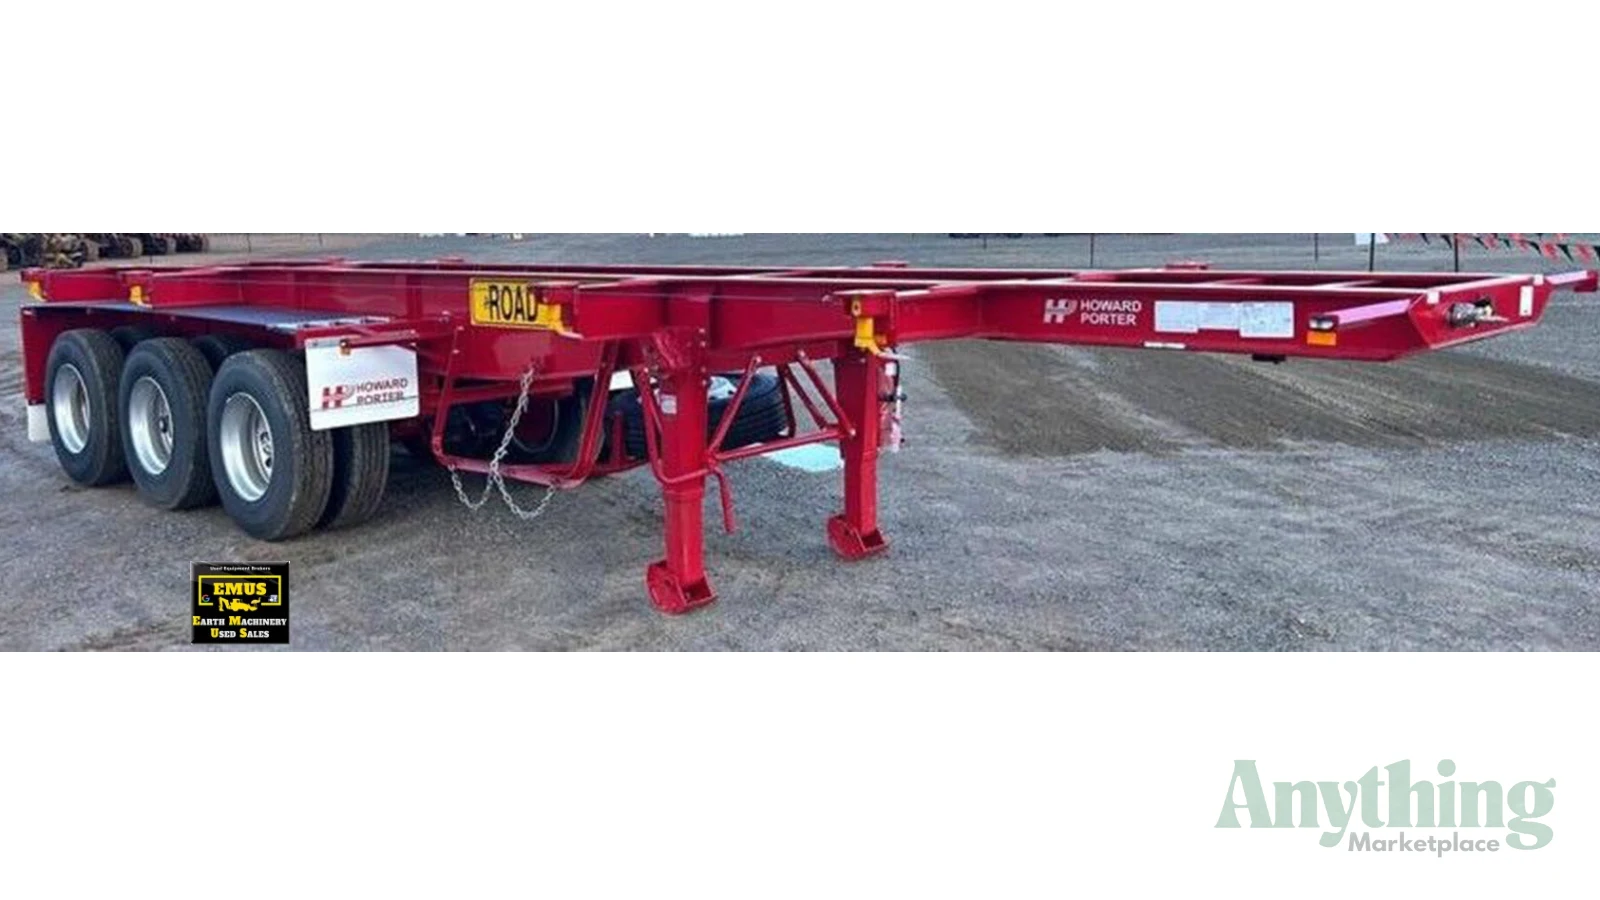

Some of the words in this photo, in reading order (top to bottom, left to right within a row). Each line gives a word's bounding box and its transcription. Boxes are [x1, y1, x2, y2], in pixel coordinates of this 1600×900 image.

[488, 284, 539, 322] ROAD
[1080, 299, 1142, 312] HOWARD
[1080, 312, 1137, 326] PORTER
[357, 378, 408, 392] HOWARD
[356, 391, 404, 406] PORTER
